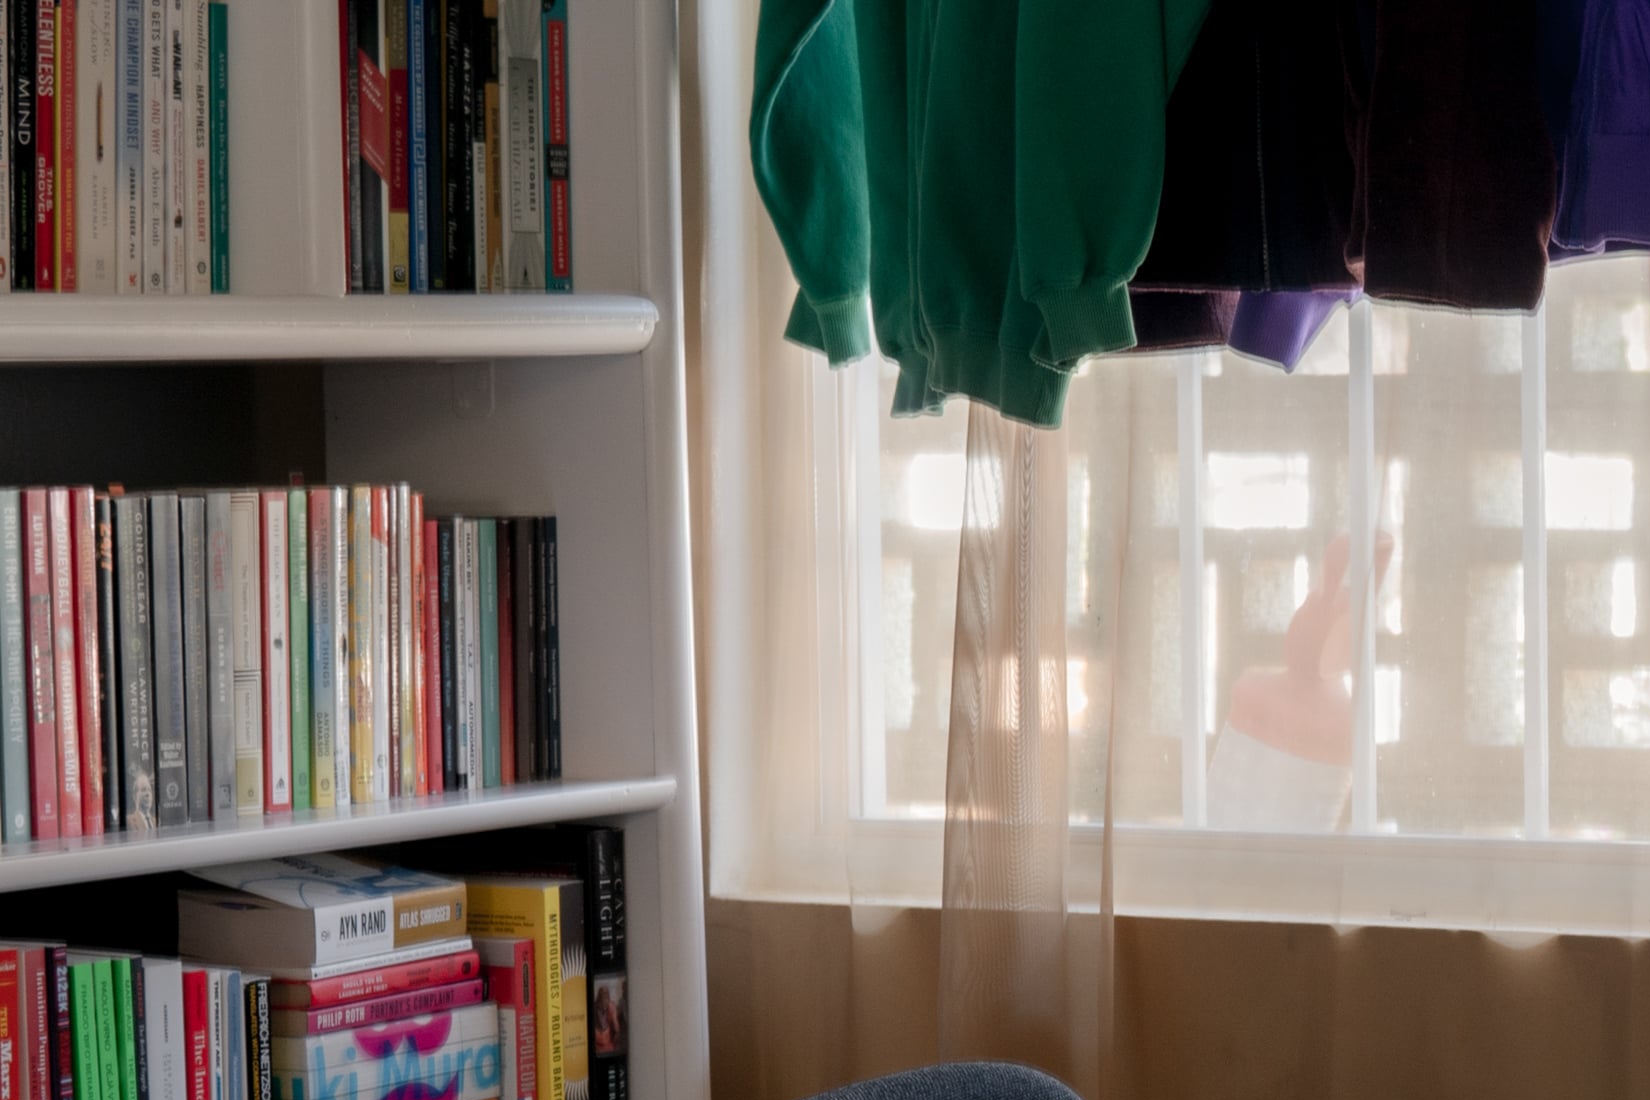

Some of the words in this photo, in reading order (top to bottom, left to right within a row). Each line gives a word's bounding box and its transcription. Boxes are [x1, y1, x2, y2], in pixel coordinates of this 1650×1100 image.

[152, 11, 160, 41] GETS
[194, 1, 206, 71] Stumbling
[126, 18, 140, 87] CHAMPION
[152, 46, 160, 79] WHAT
[18, 78, 31, 145] MIND
[126, 92, 140, 150] MINDSET
[152, 100, 160, 124] AND
[196, 85, 205, 149] HAPPINESS
[350, 69, 360, 164] LUCRETIUS
[152, 128, 160, 156] WHY
[38, 156, 46, 224] GROVER
[151, 167, 161, 198] Alvin
[197, 159, 205, 196] DANIEL
[151, 217, 161, 247] Roth
[197, 200, 206, 243] GILBERT
[4, 507, 16, 548] ERICH
[33, 515, 45, 575] LUTTWAK
[135, 512, 145, 565] GOING
[320, 519, 329, 577] STRANGE
[57, 518, 71, 618] MONEYBALL
[136, 571, 146, 624] CLEAR
[321, 582, 330, 624] ORDER
[322, 640, 330, 688] THINGS
[61, 660, 73, 733] MICHAEL
[129, 681, 139, 749] WRIGHT
[138, 667, 150, 761] LAWRENCE
[64, 740, 77, 794] LEWIS
[338, 914, 358, 941] AYN
[360, 909, 387, 938] RAND
[399, 911, 419, 930] ATLAS
[420, 904, 451, 927] SHRUGGED
[599, 879, 614, 961] LIGHT
[614, 878, 625, 945] CAVE
[548, 913, 561, 1001] MYTHOLOGIES
[36, 970, 45, 1031] Intuition
[81, 984, 90, 1029] FRANCO
[101, 981, 109, 1016] PAOLO
[343, 981, 364, 989] SHOULD
[364, 978, 375, 987] YOU
[258, 982, 271, 1048] FRIEDRICH
[317, 1010, 342, 1030] PHILIP
[344, 1006, 366, 1025] ROTH
[413, 989, 455, 1011] COMPLAINT
[37, 1034, 47, 1080] Pumps
[103, 1019, 111, 1051] VIRNO
[193, 1030, 205, 1066] The
[251, 1040, 259, 1059] WITH
[519, 1013, 535, 1093] NAPOLEON
[551, 1015, 562, 1063] ROLAND
